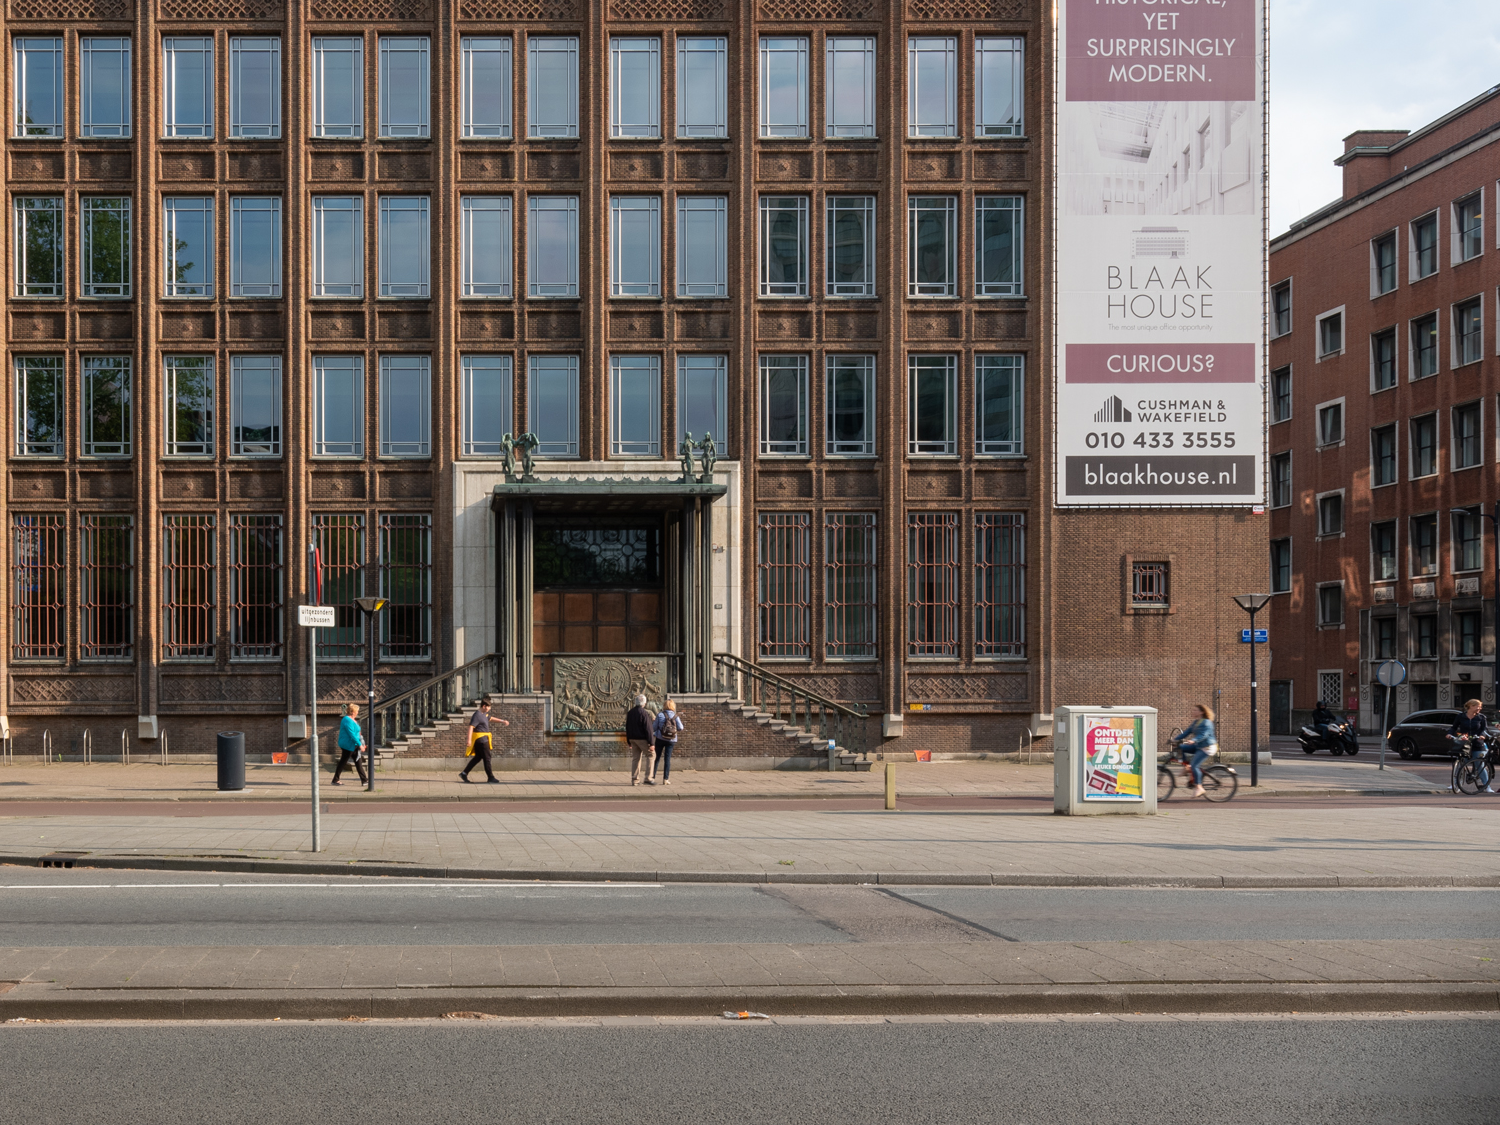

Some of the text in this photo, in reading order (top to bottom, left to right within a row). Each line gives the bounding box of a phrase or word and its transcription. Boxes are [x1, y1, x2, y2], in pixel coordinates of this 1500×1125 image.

[1143, 12, 1180, 30] YET
[1087, 38, 1236, 57] SURPRISINGLY
[1108, 64, 1213, 82] MODERN.
[1107, 265, 1213, 290] BLAAK
[1107, 294, 1213, 318] HOUSE
[1137, 324, 1158, 333] unique
[1160, 323, 1176, 331] office
[1178, 324, 1213, 333] opportunity
[1106, 354, 1215, 373] CURIOUS?
[1137, 400, 1226, 410] CUSHMAN &
[1137, 412, 1227, 423] WAKEFIELD
[1085, 432, 1236, 449] 010 433 3555
[1084, 462, 1237, 485] blaakhouse.nl
[305, 616, 330, 624] lijnbussen
[1094, 728, 1134, 737] ONTDEK
[1094, 744, 1135, 764] 750
